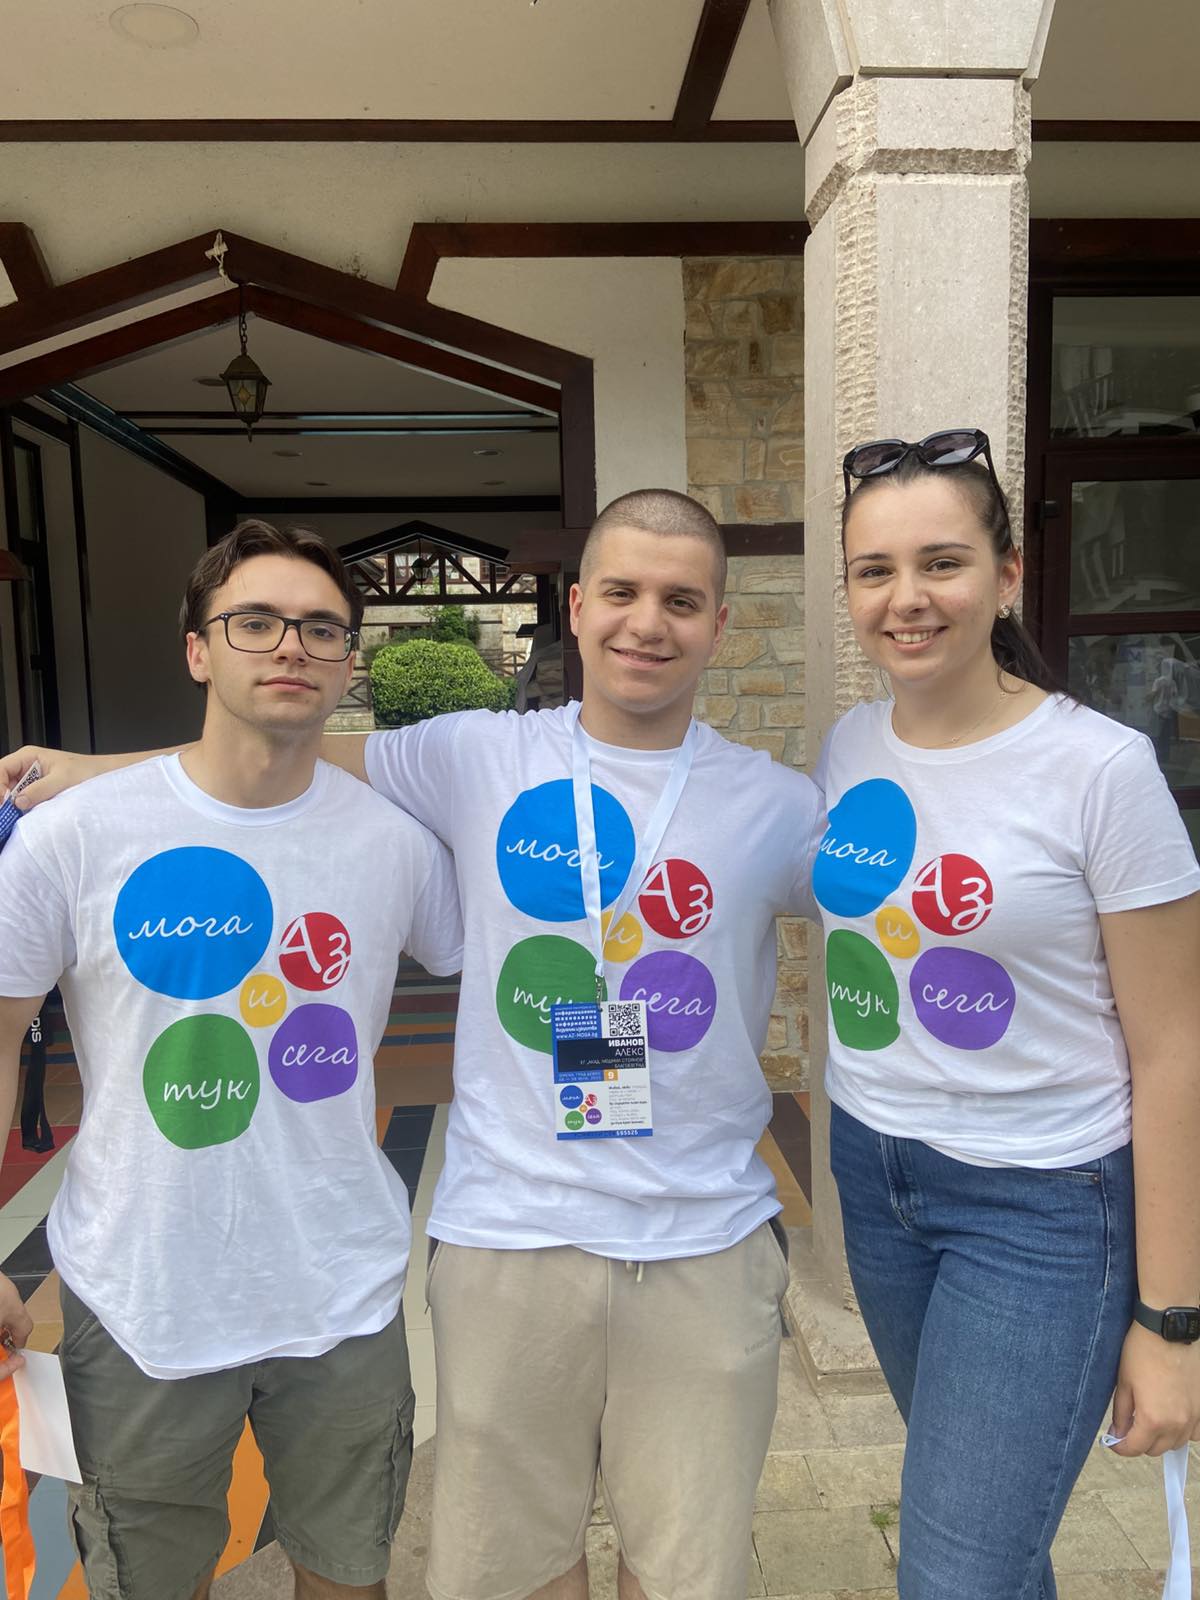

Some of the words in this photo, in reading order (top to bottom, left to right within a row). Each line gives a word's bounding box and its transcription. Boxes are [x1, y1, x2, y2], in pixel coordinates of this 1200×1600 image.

[820, 838, 897, 867] мога
[638, 861, 713, 934] Аз
[912, 857, 994, 931] Аз
[128, 912, 254, 940] мога
[886, 919, 913, 941] и
[278, 915, 352, 983] Аз
[248, 988, 282, 1009] и
[513, 986, 574, 1024] ту
[632, 987, 712, 1016] сега
[831, 981, 891, 1017] тук
[922, 983, 1009, 1013] сега
[281, 1043, 357, 1067] сега
[608, 1039, 645, 1047] ИВАНОВ
[615, 1047, 644, 1057] АЛЕКС
[607, 1071, 615, 1080] 9
[163, 1077, 253, 1110] тук
